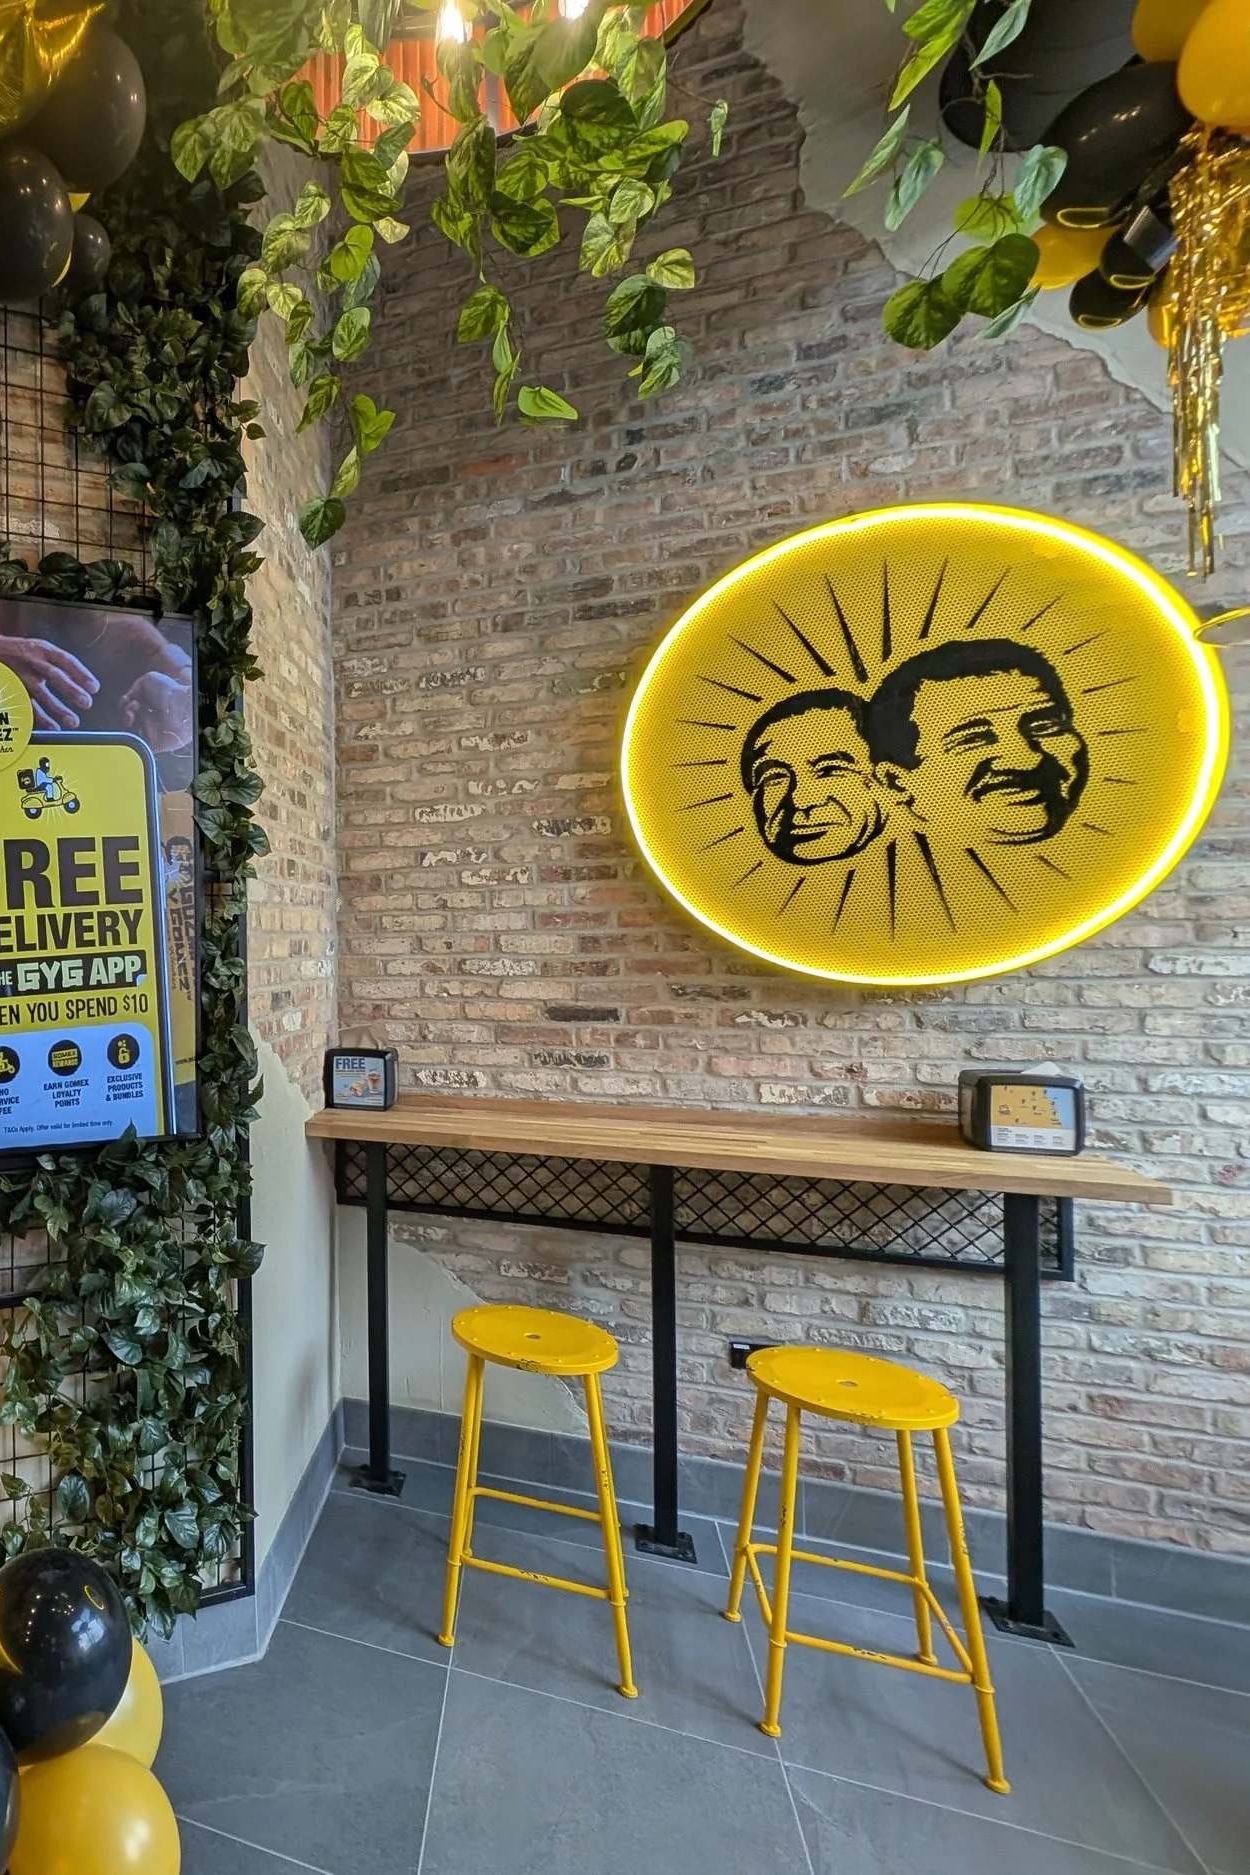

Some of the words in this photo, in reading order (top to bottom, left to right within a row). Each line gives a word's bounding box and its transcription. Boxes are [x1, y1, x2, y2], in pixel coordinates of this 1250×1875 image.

[16, 959, 84, 992] GYG
[89, 955, 142, 986] APP
[26, 1001, 59, 1024] YOU
[65, 996, 118, 1021] SPEND
[122, 993, 148, 1014] $10
[335, 1057, 366, 1070] FREE
[107, 1072, 143, 1084] EXCLUSIVE
[43, 1082, 63, 1091] EARN
[64, 1078, 90, 1089] GOMEX
[107, 1081, 143, 1092] PRODUCTS
[52, 1088, 82, 1099] LOYALTY
[112, 1090, 144, 1101] BUNDLES
[54, 1098, 81, 1108] POINTS
[50, 1122, 62, 1130] valid
